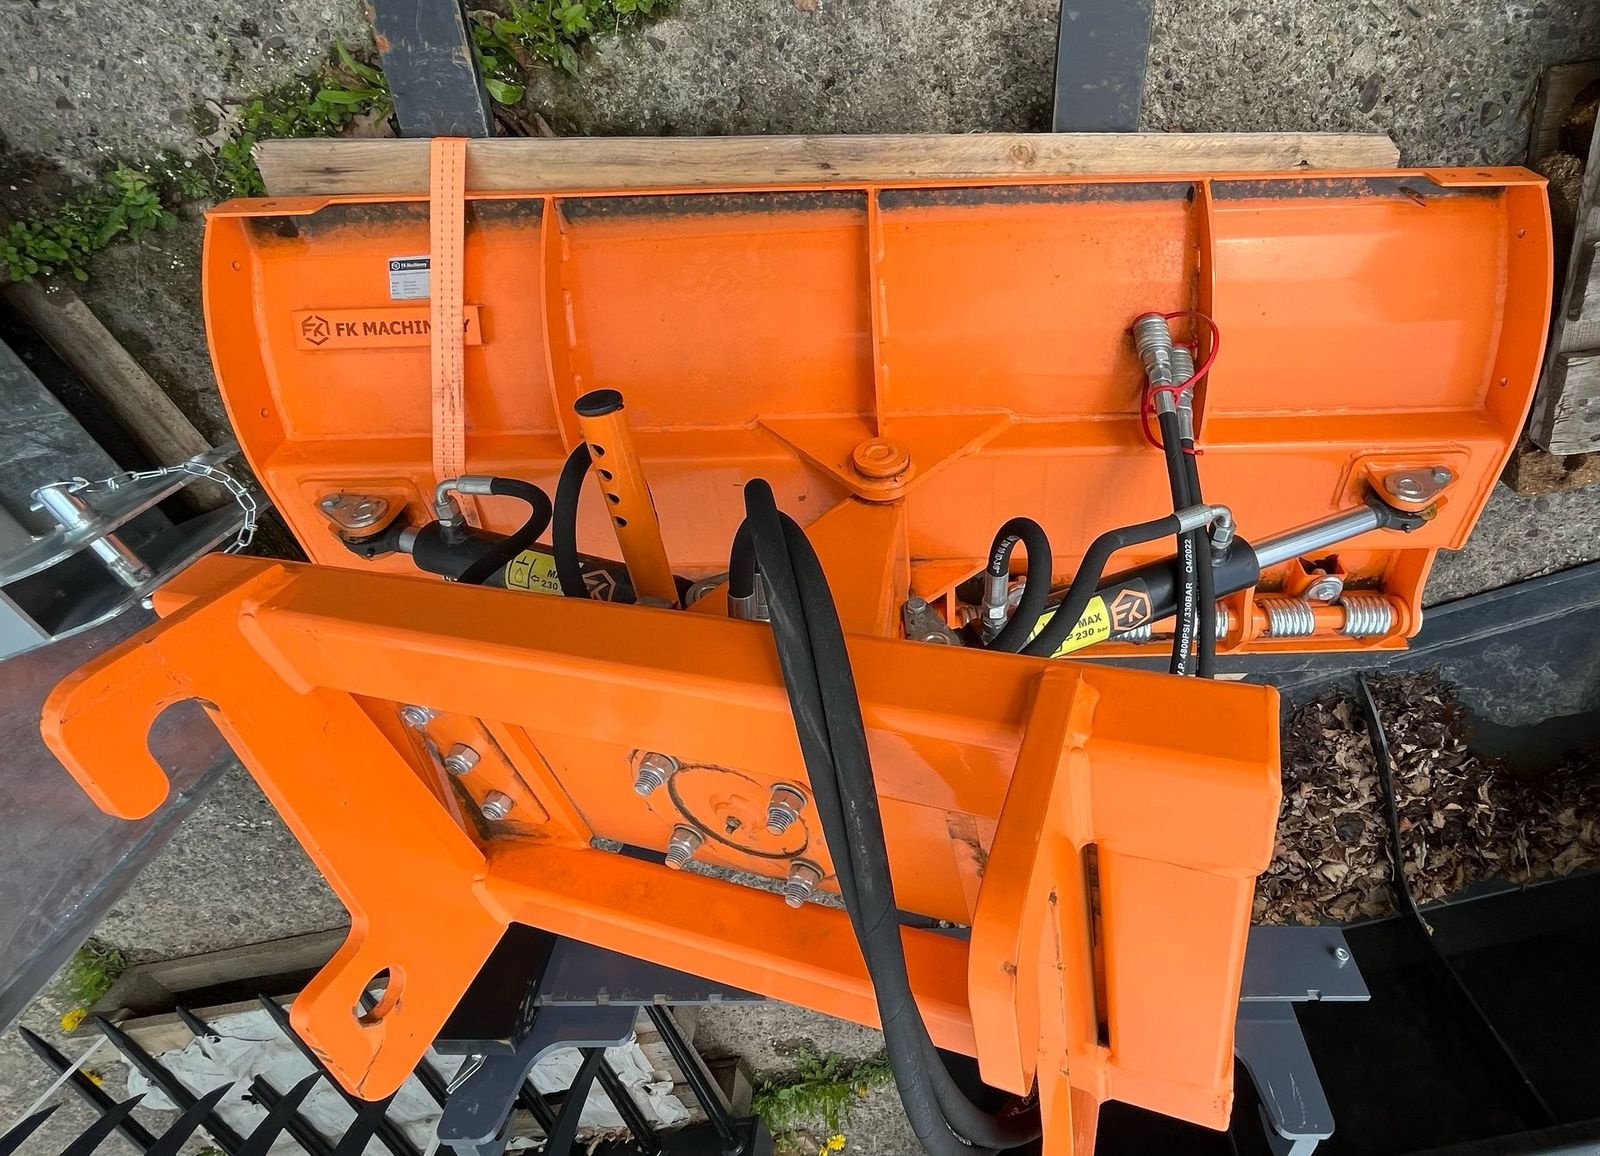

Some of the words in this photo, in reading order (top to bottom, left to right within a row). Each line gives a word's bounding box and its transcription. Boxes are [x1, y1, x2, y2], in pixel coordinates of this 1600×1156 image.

[336, 322, 358, 337] FK
[363, 318, 471, 336] MACHINY
[1184, 539, 1193, 574] Q4/2022
[541, 580, 558, 591] 230
[1184, 582, 1193, 618] 330BAR
[1078, 613, 1102, 628] MAX
[1075, 628, 1095, 641] 230
[1179, 624, 1191, 659] 4800PSI
